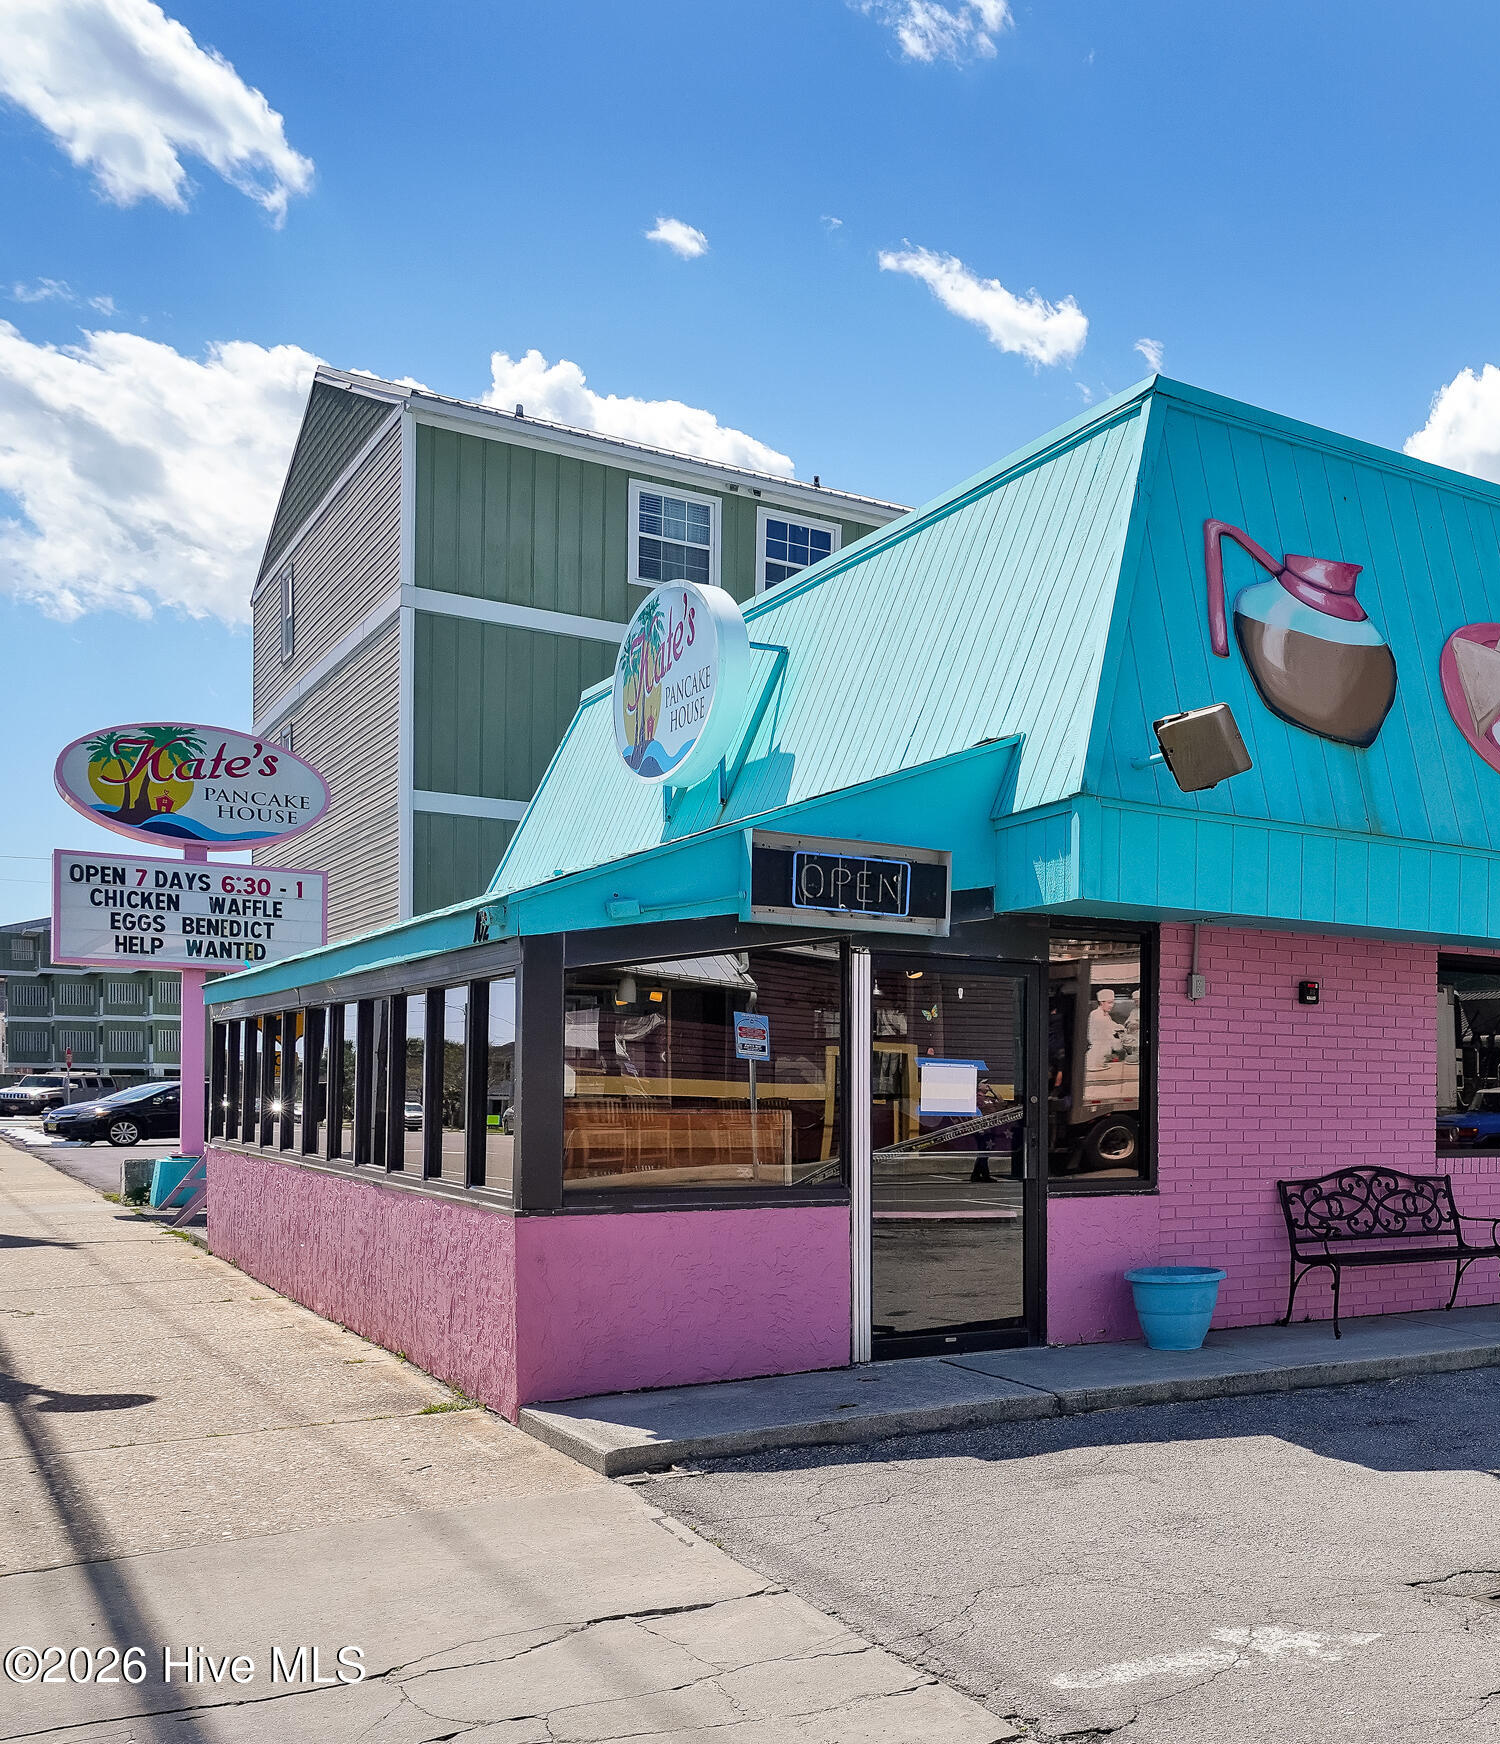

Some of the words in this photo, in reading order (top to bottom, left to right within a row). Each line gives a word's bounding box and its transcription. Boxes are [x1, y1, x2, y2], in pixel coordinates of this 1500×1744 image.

[627, 592, 696, 712] Kate's
[665, 665, 711, 708] PANCAKE
[670, 696, 705, 732] HOUSE
[100, 738, 279, 783] Kate's
[204, 787, 310, 810] PANCAKE
[217, 804, 297, 825] HOUSE
[69, 864, 126, 885] OPEN
[135, 868, 147, 886] 7
[154, 871, 211, 891] DAYS
[221, 875, 271, 896] 6:30
[296, 881, 303, 898] 1
[799, 862, 900, 906] OPEN
[90, 888, 180, 911] CHICKEN
[209, 896, 283, 918] WAFFLE
[110, 912, 166, 932] EGGS
[182, 916, 275, 939] BENEDICT
[114, 935, 164, 954] HELP
[186, 939, 266, 961] WANTED
